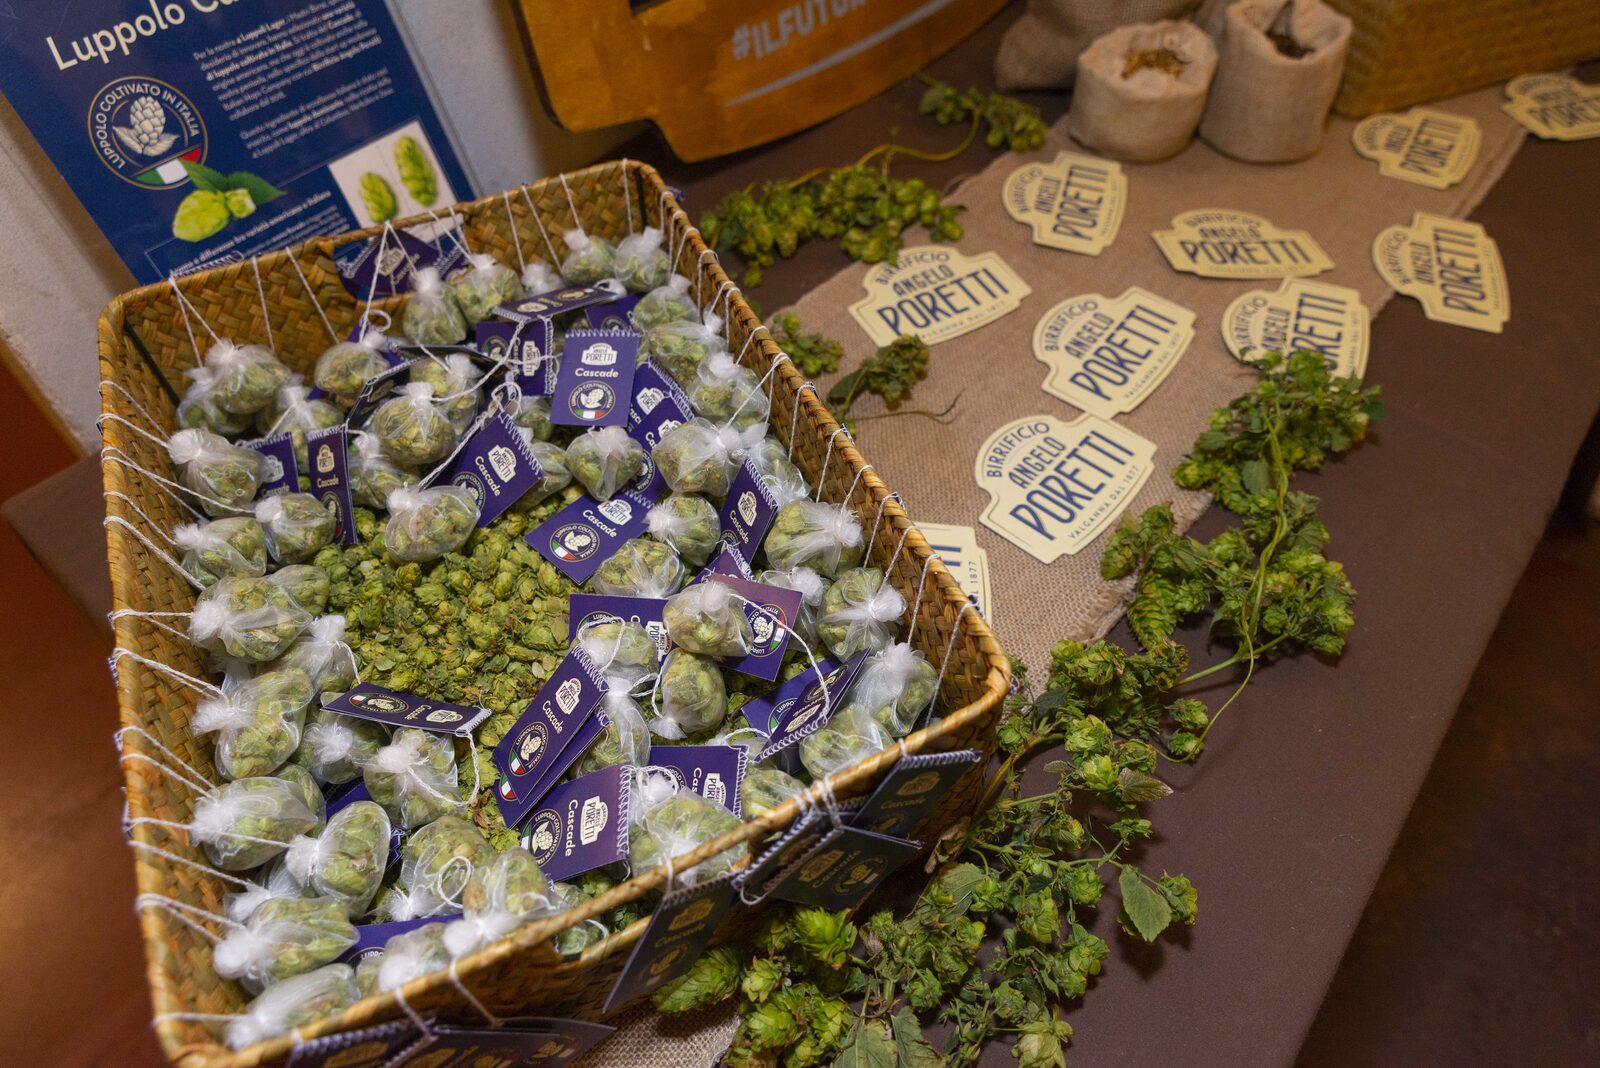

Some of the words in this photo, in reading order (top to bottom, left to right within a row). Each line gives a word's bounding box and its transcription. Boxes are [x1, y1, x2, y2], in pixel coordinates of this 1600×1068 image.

[46, 0, 185, 70] Luppolo
[100, 83, 160, 112] COLTIVATO
[163, 90, 176, 104] IN
[175, 101, 199, 136] ITALIA
[96, 113, 125, 168] LUPPOLO
[1400, 118, 1461, 177] PORETTI
[1052, 164, 1108, 240] PORETTI
[1180, 240, 1312, 264] PORETTI
[892, 264, 954, 296] ANGELO
[1433, 228, 1489, 315] PORETTI
[877, 268, 1009, 336] PORETTI
[1044, 301, 1098, 351] BIRRIFICIO
[1064, 313, 1114, 359] ANGELO
[586, 353, 613, 361] PORETTI
[1069, 305, 1176, 400] PORETTI
[575, 368, 619, 377] Cascade
[492, 450, 511, 478] PORETTI
[986, 422, 1050, 477] BIRRIFICIO
[1008, 436, 1066, 489] ANGELO
[316, 474, 340, 488] Cascade
[476, 456, 500, 496] Cascade
[1009, 430, 1135, 540] PORETTI
[603, 503, 627, 522] PORETTI
[1068, 502, 1111, 539] VALGANNA
[1111, 486, 1126, 500] DAL
[1124, 465, 1140, 484] 1877
[555, 525, 577, 538] LUPPOLO
[578, 526, 597, 542] COLTIVATO
[582, 510, 617, 538] Cascade
[730, 510, 748, 544] Cascade
[969, 561, 978, 584] 1877
[404, 704, 432, 720] Cascade
[560, 685, 575, 710] PORETTI
[777, 701, 794, 712] LUPPO
[543, 700, 563, 733] Cascade
[535, 812, 555, 822] LUPPOLO
[550, 818, 560, 852] COLTIVATO
[565, 800, 578, 857] Cascade
[584, 802, 596, 839] PORETTI
